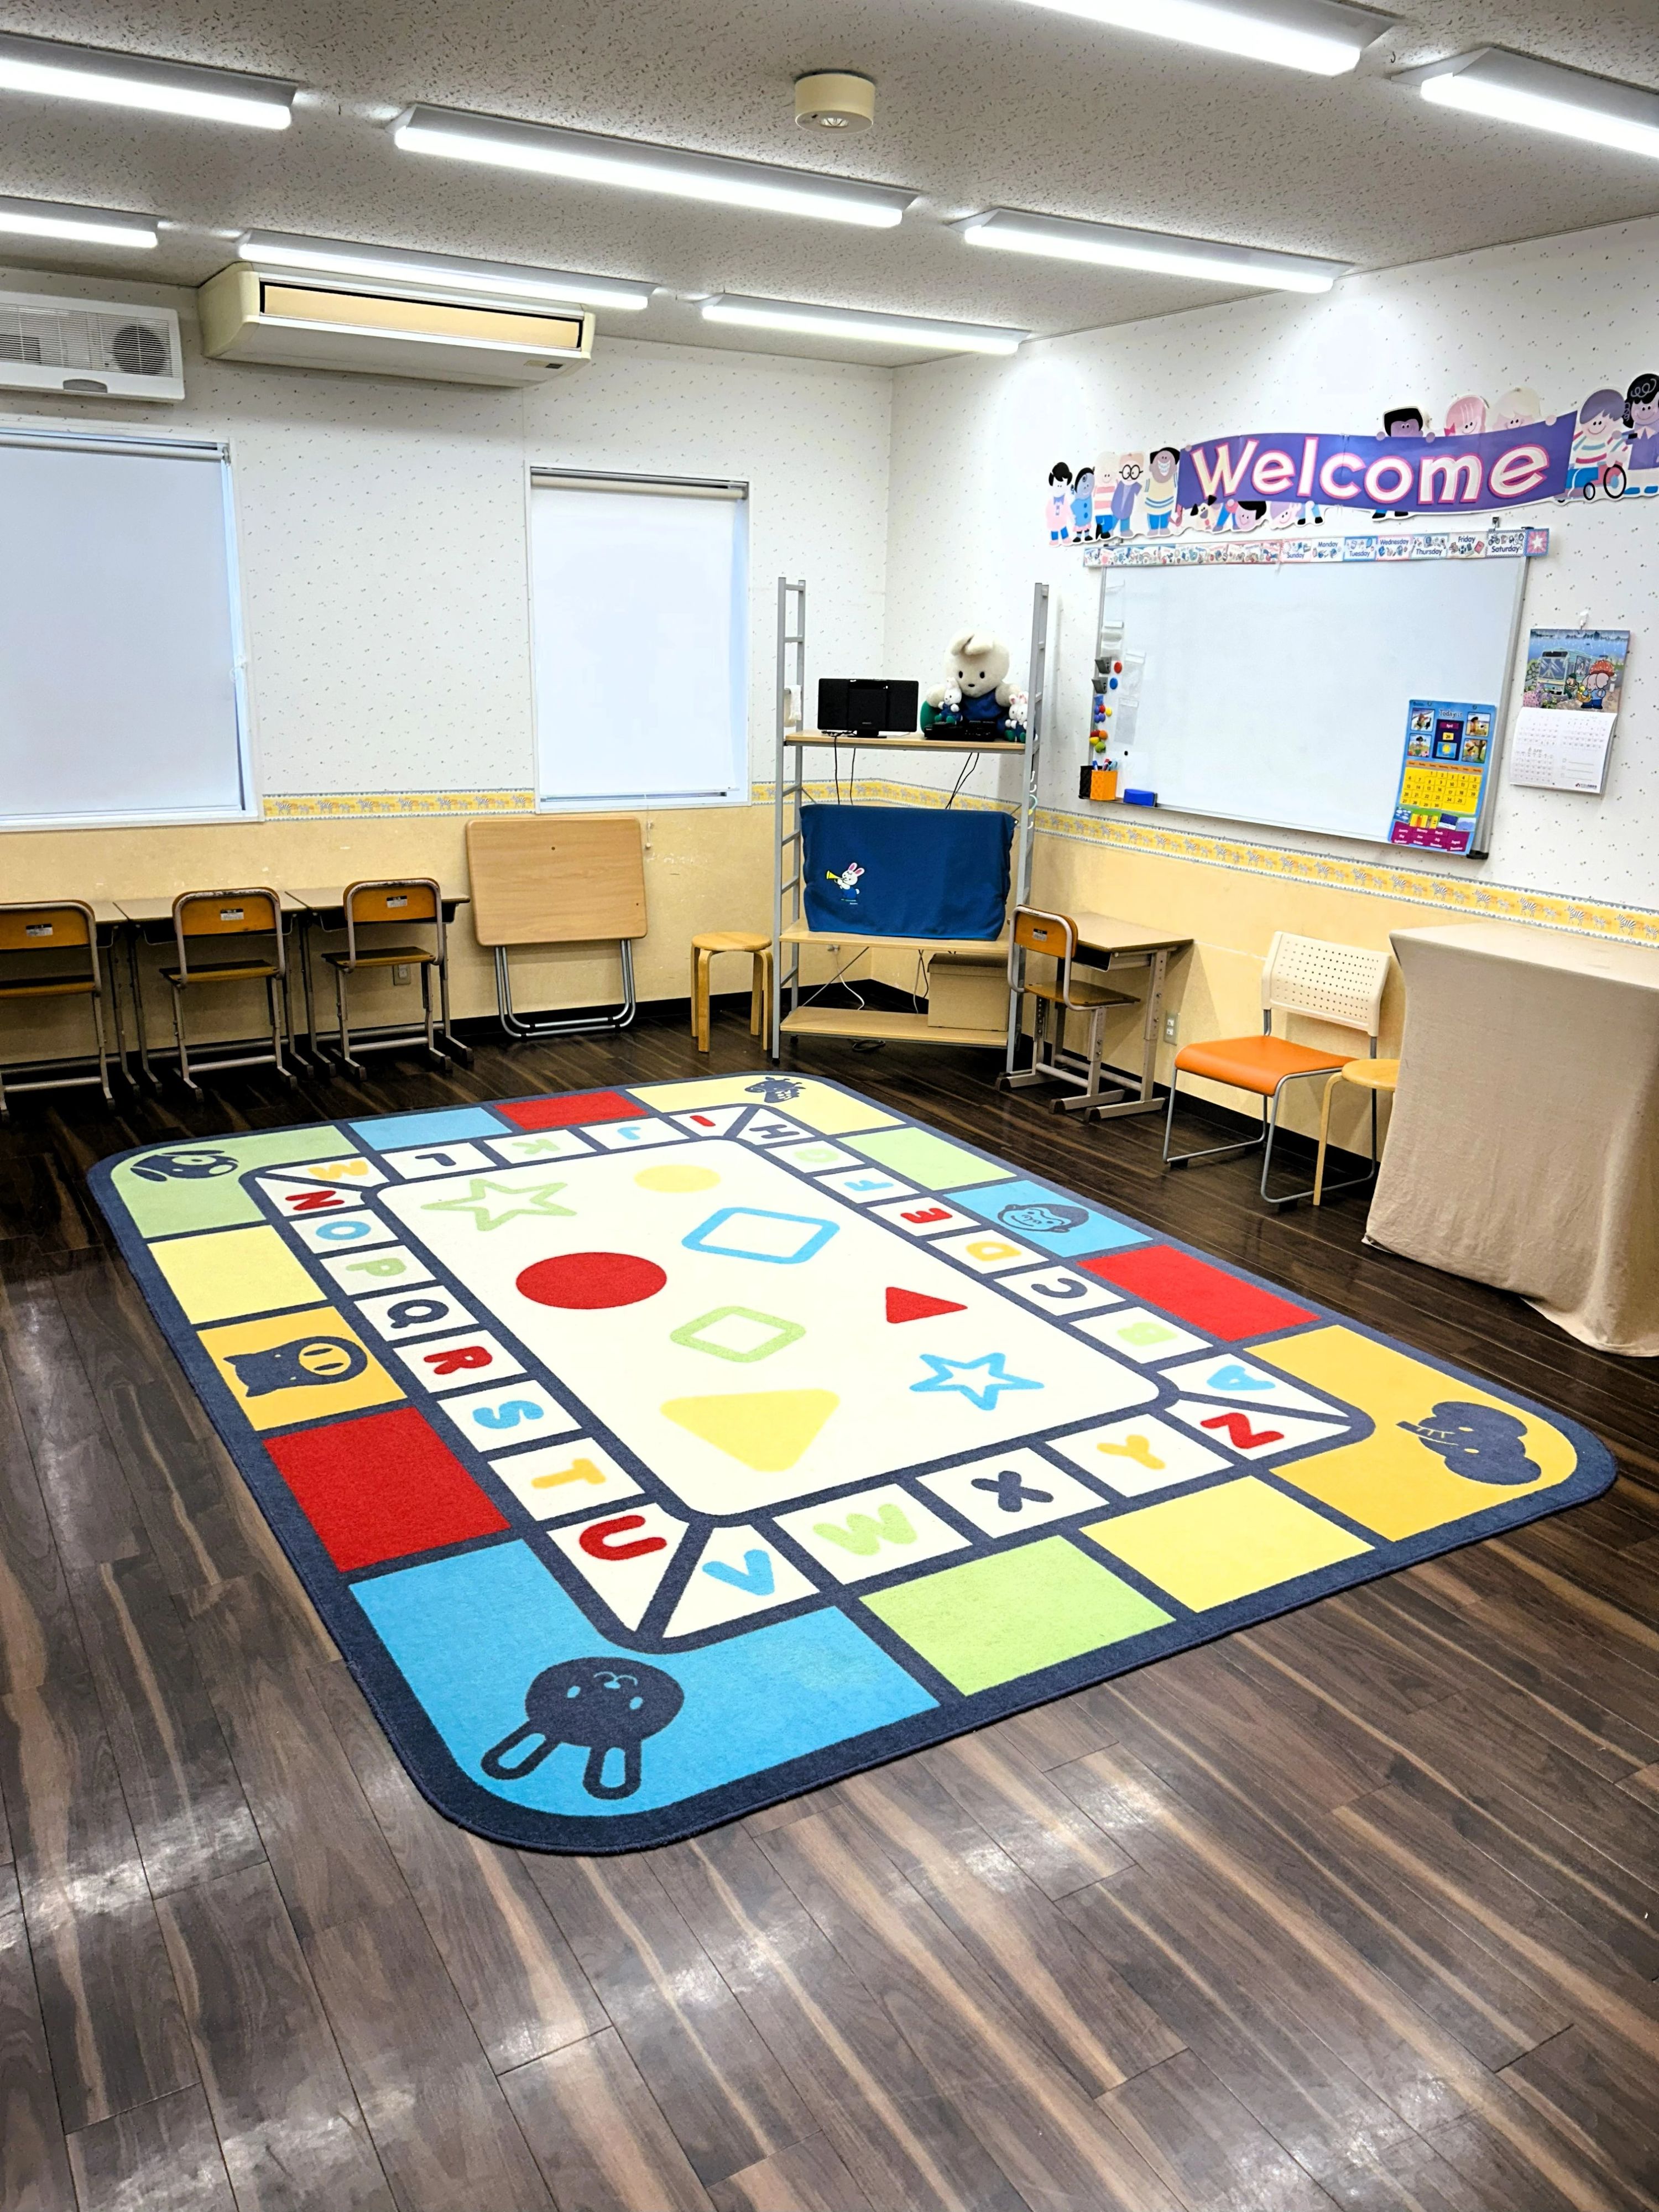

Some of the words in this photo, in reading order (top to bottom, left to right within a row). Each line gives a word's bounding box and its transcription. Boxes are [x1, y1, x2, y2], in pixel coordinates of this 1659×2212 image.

[1191, 437, 1548, 504] Welcome
[1439, 709, 1455, 718] Today
[748, 1124, 800, 1139] H
[306, 1158, 369, 1181] M
[414, 1152, 457, 1167] L
[512, 1138, 559, 1155] K
[617, 1126, 641, 1140] J
[689, 1114, 717, 1128] I
[793, 1147, 840, 1164] G
[843, 1178, 894, 1193] F
[284, 1190, 346, 1212] N
[900, 1207, 953, 1224] E
[315, 1220, 372, 1241] O
[965, 1240, 1022, 1263] D
[345, 1256, 408, 1277] P
[1030, 1277, 1088, 1299] C
[387, 1298, 450, 1329] Q
[1117, 1322, 1177, 1346] B
[422, 1345, 493, 1376] R
[1206, 1364, 1276, 1392] A
[472, 1399, 545, 1430] S
[530, 1457, 608, 1490] T
[701, 1548, 775, 1597] V
[812, 1503, 918, 1557] W
[970, 1470, 1055, 1513] X
[1096, 1433, 1167, 1472] Y
[1199, 1411, 1285, 1450] Z
[577, 1514, 669, 1562] U
